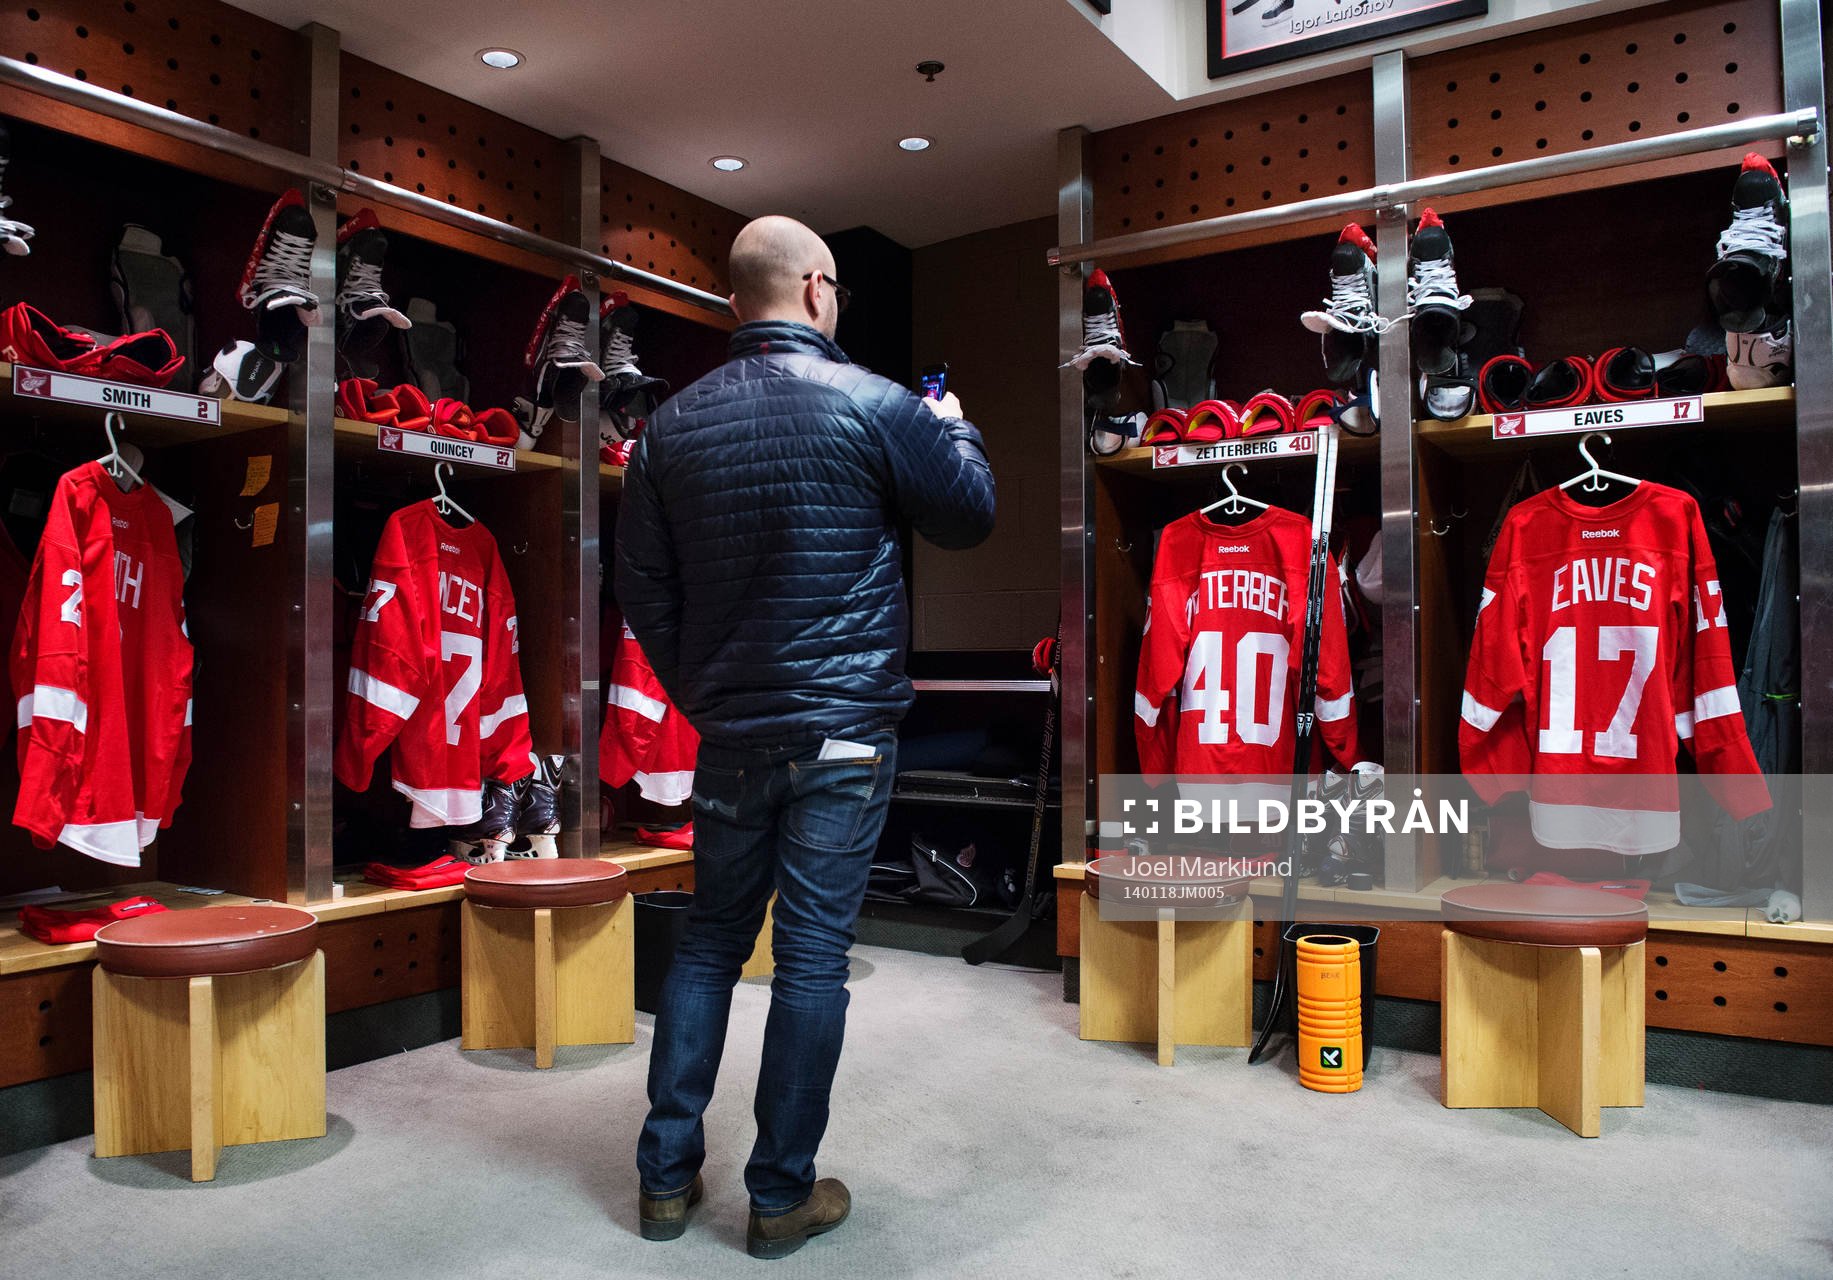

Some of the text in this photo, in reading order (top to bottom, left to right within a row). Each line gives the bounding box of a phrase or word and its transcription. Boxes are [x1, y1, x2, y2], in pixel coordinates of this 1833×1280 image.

[1289, 0, 1394, 34] Igor Larionov
[102, 387, 208, 418] SMITH 2
[1573, 401, 1691, 426] EAVES 17
[430, 440, 510, 466] QUINCEY 27
[1195, 435, 1311, 460] ZETTERBERG 40
[1218, 545, 1250, 554] Reebok
[1582, 529, 1620, 539] Reebok
[61, 569, 82, 627] 2
[360, 578, 397, 622] 7
[1552, 557, 1656, 612] EAVES
[506, 616, 519, 654] 2
[441, 630, 483, 746] 7
[1180, 631, 1290, 747] 40
[1539, 626, 1660, 759] 17
